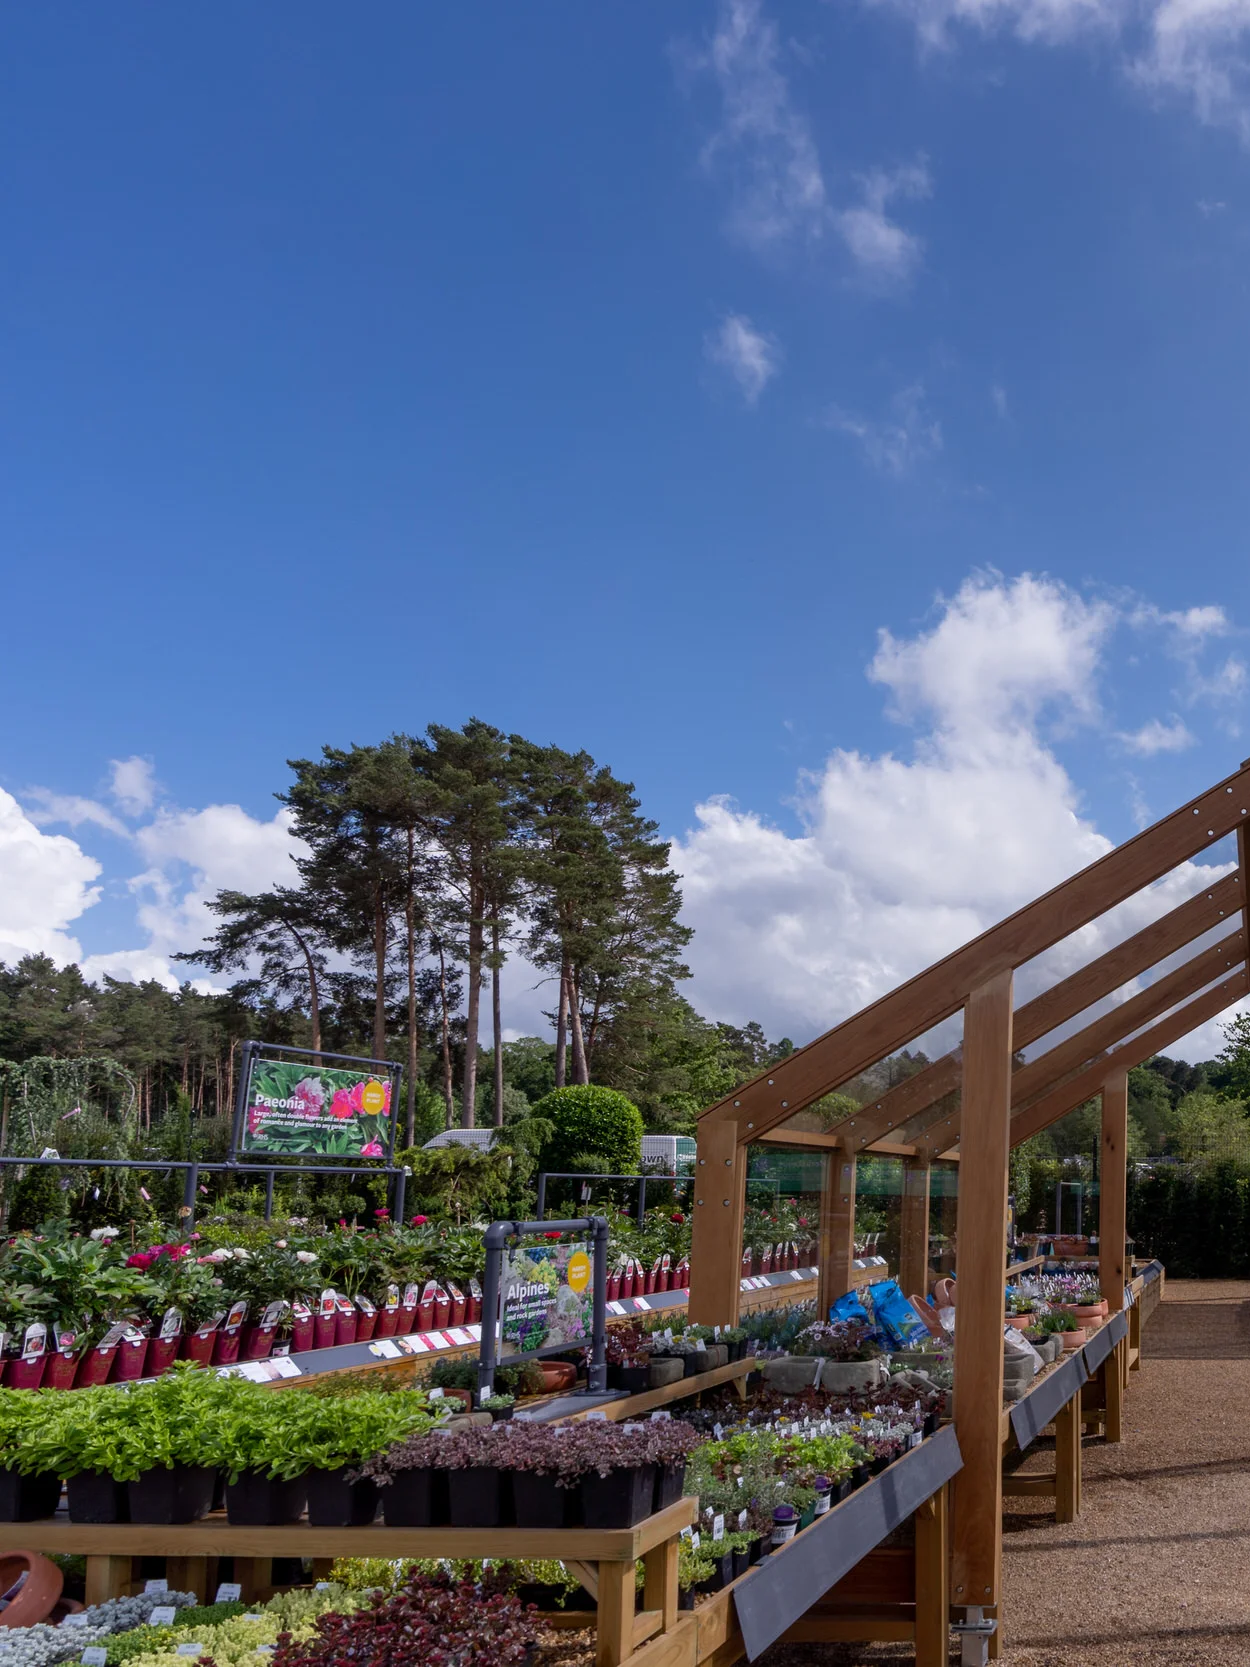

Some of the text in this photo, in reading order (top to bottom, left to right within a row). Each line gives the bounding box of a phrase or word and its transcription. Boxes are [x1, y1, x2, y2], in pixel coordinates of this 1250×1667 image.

[255, 1094, 305, 1110] Paeonia
[254, 1110, 271, 1118] Large,
[294, 1120, 315, 1128] glamour
[506, 1281, 550, 1302] Alpines
[507, 1304, 520, 1312] Ideal
[528, 1300, 541, 1308] small
[541, 1298, 557, 1307] spaces
[506, 1309, 547, 1321] and rock gardens
